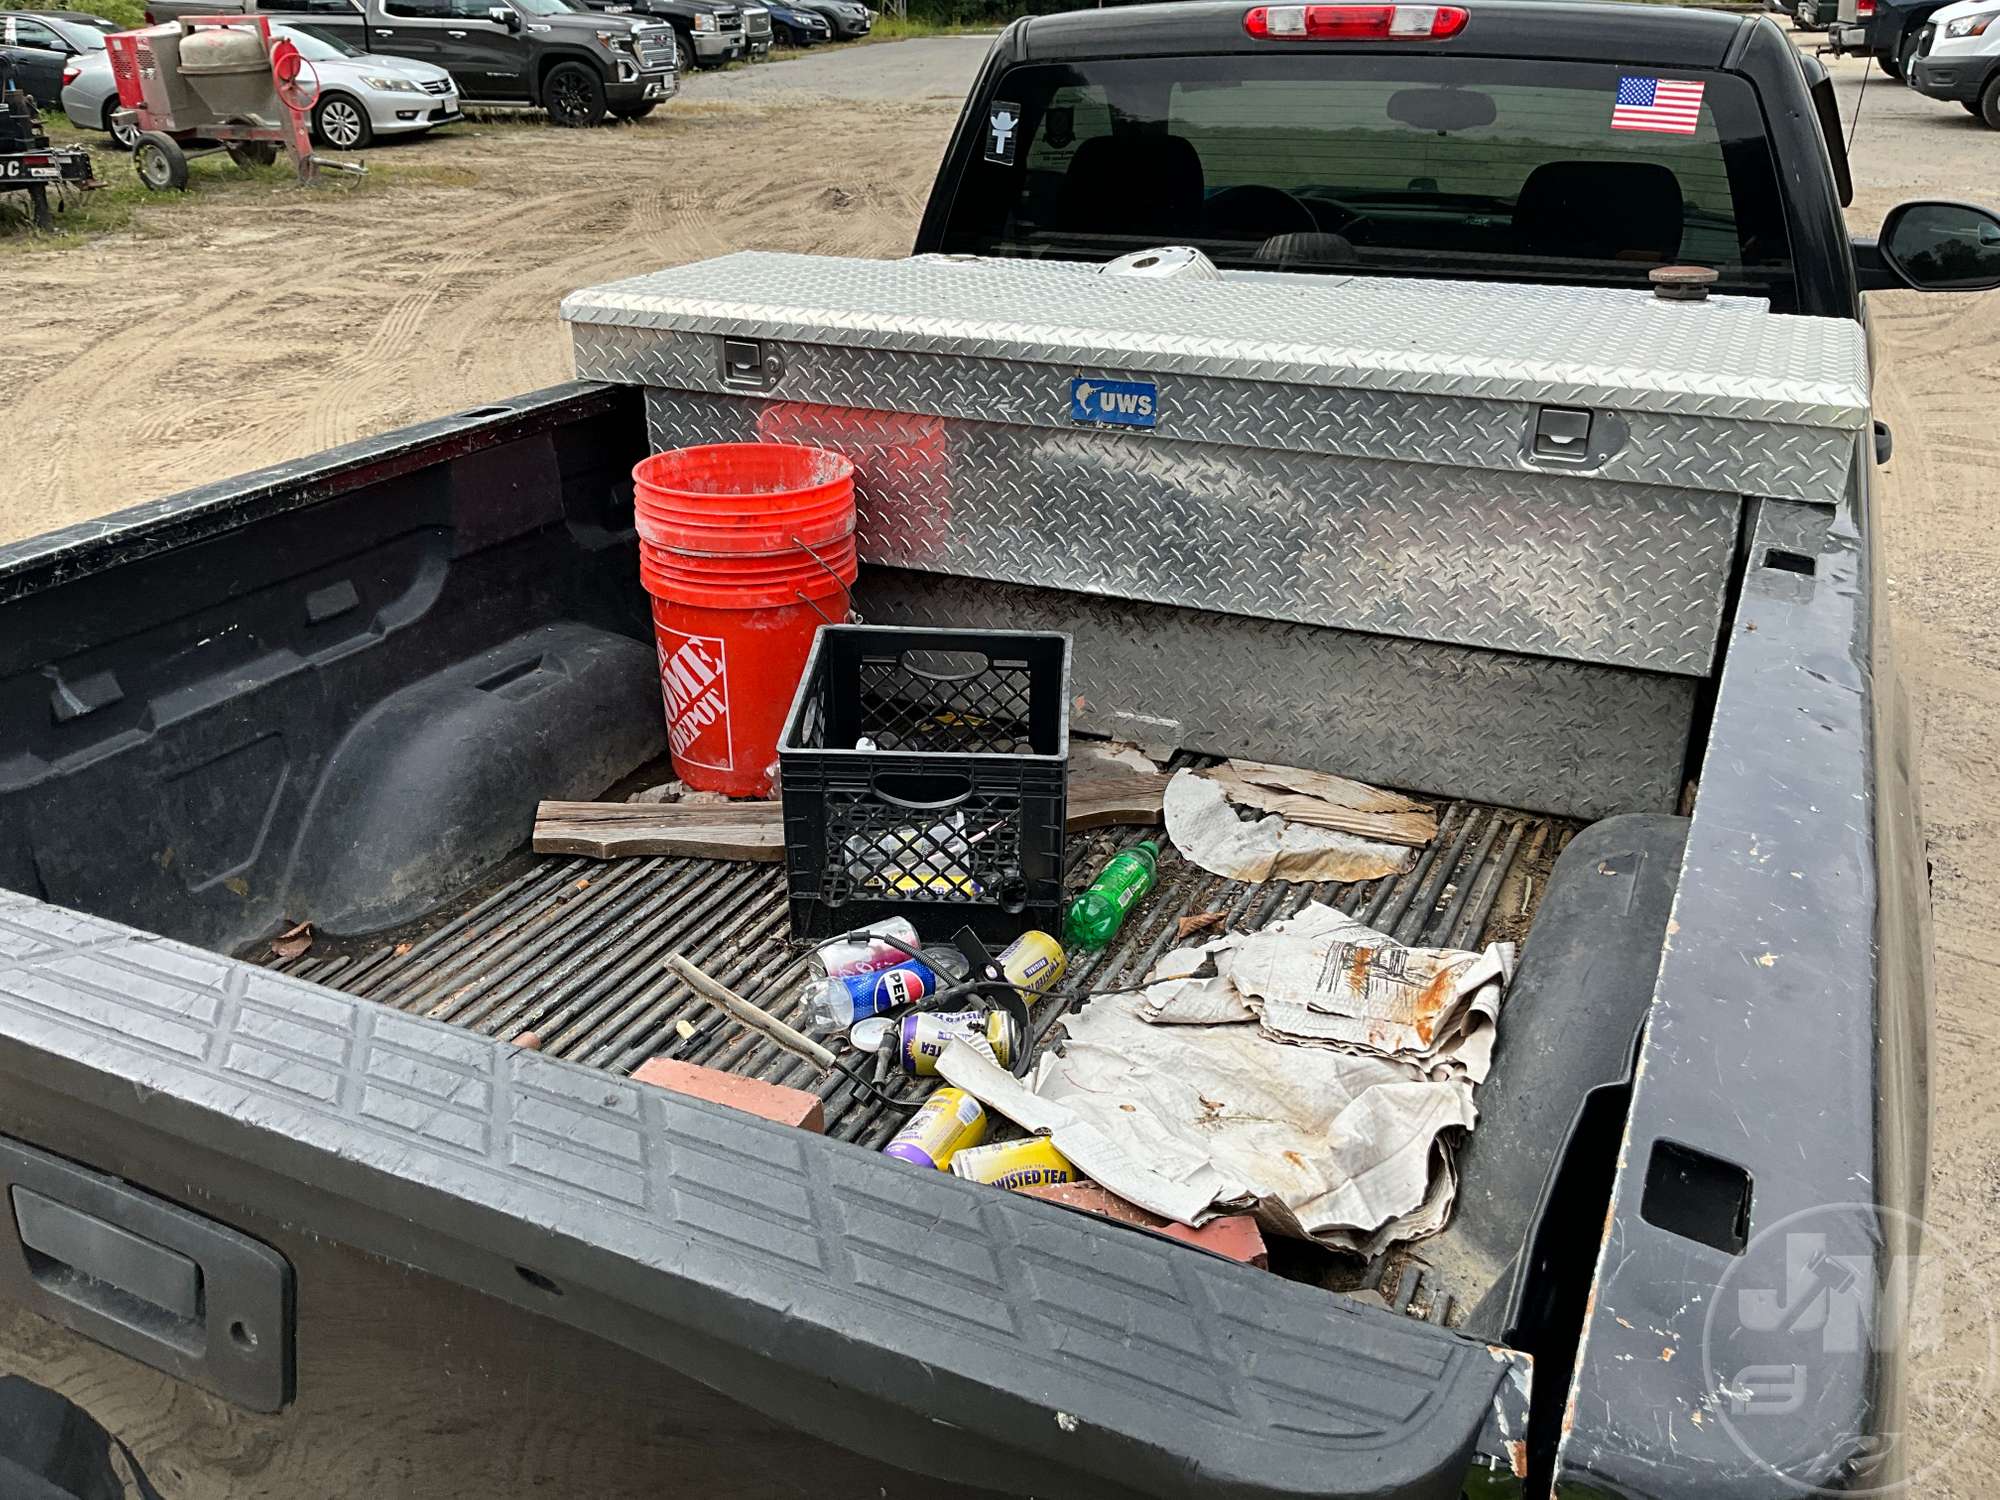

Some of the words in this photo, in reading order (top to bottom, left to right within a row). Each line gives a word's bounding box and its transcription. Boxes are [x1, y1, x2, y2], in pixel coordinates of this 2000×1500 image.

[1100, 392, 1152, 416] UWS
[661, 636, 724, 723] OME
[889, 972, 906, 1003] PEP
[992, 1169, 1041, 1190] WISTED
[1043, 1169, 1067, 1184] TEA
